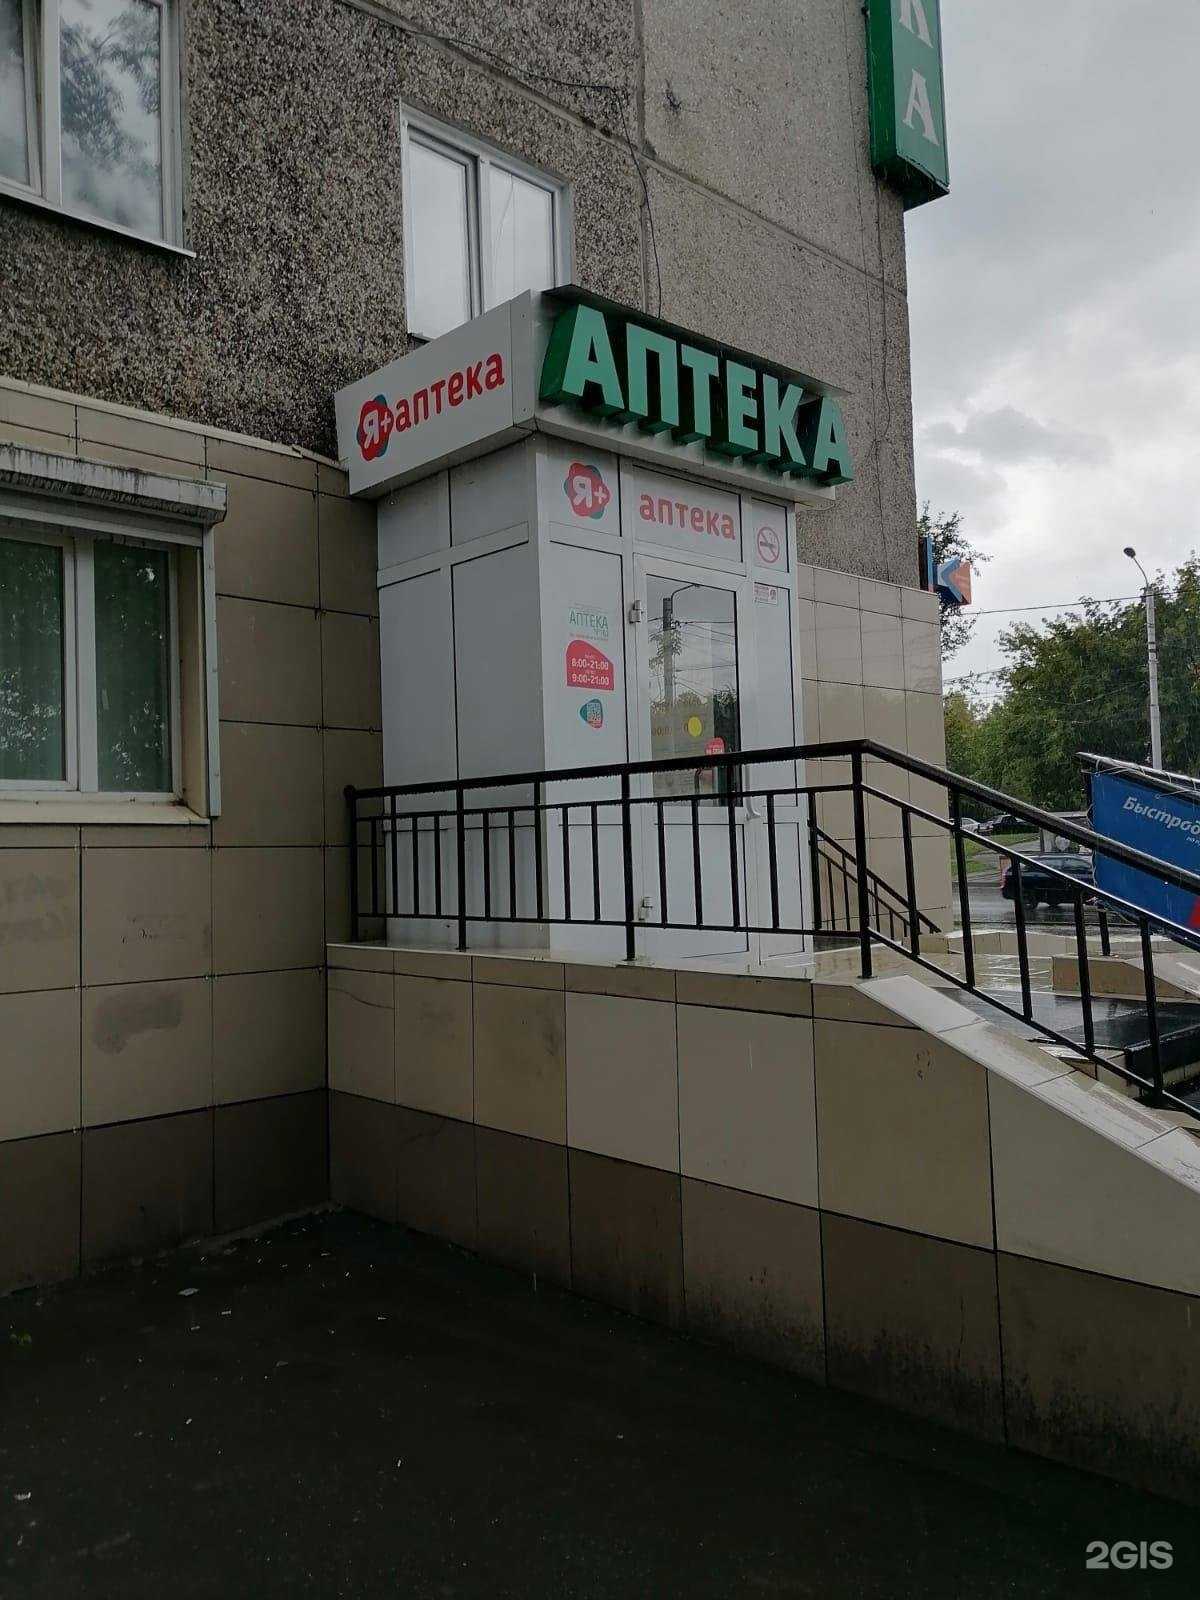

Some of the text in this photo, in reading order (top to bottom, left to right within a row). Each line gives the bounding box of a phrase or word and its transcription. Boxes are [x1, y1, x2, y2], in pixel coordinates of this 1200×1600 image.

[396, 352, 505, 432] аптека
[562, 303, 853, 482] АПТЕКА
[639, 493, 736, 541] аптека
[569, 610, 609, 629] АПТЕКА
